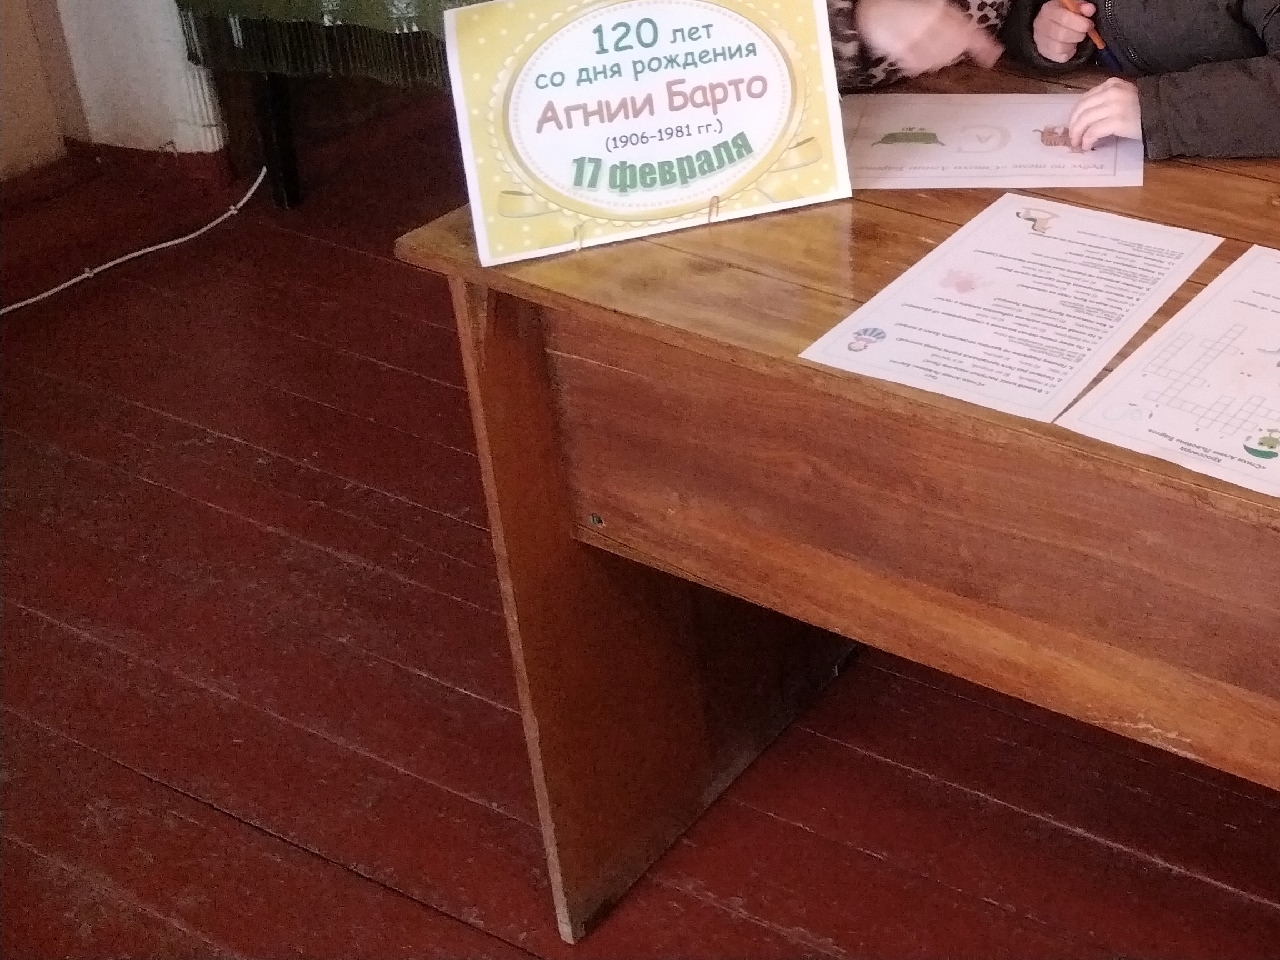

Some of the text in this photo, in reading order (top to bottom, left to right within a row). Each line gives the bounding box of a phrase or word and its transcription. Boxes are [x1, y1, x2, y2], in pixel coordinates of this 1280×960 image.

[591, 17, 714, 55] 120 лет
[535, 42, 757, 90] со дня рождения
[536, 74, 769, 134] Агнии Барто
[605, 118, 724, 152] (1906-1981 гг.)
[572, 132, 755, 193] 17 февраля
